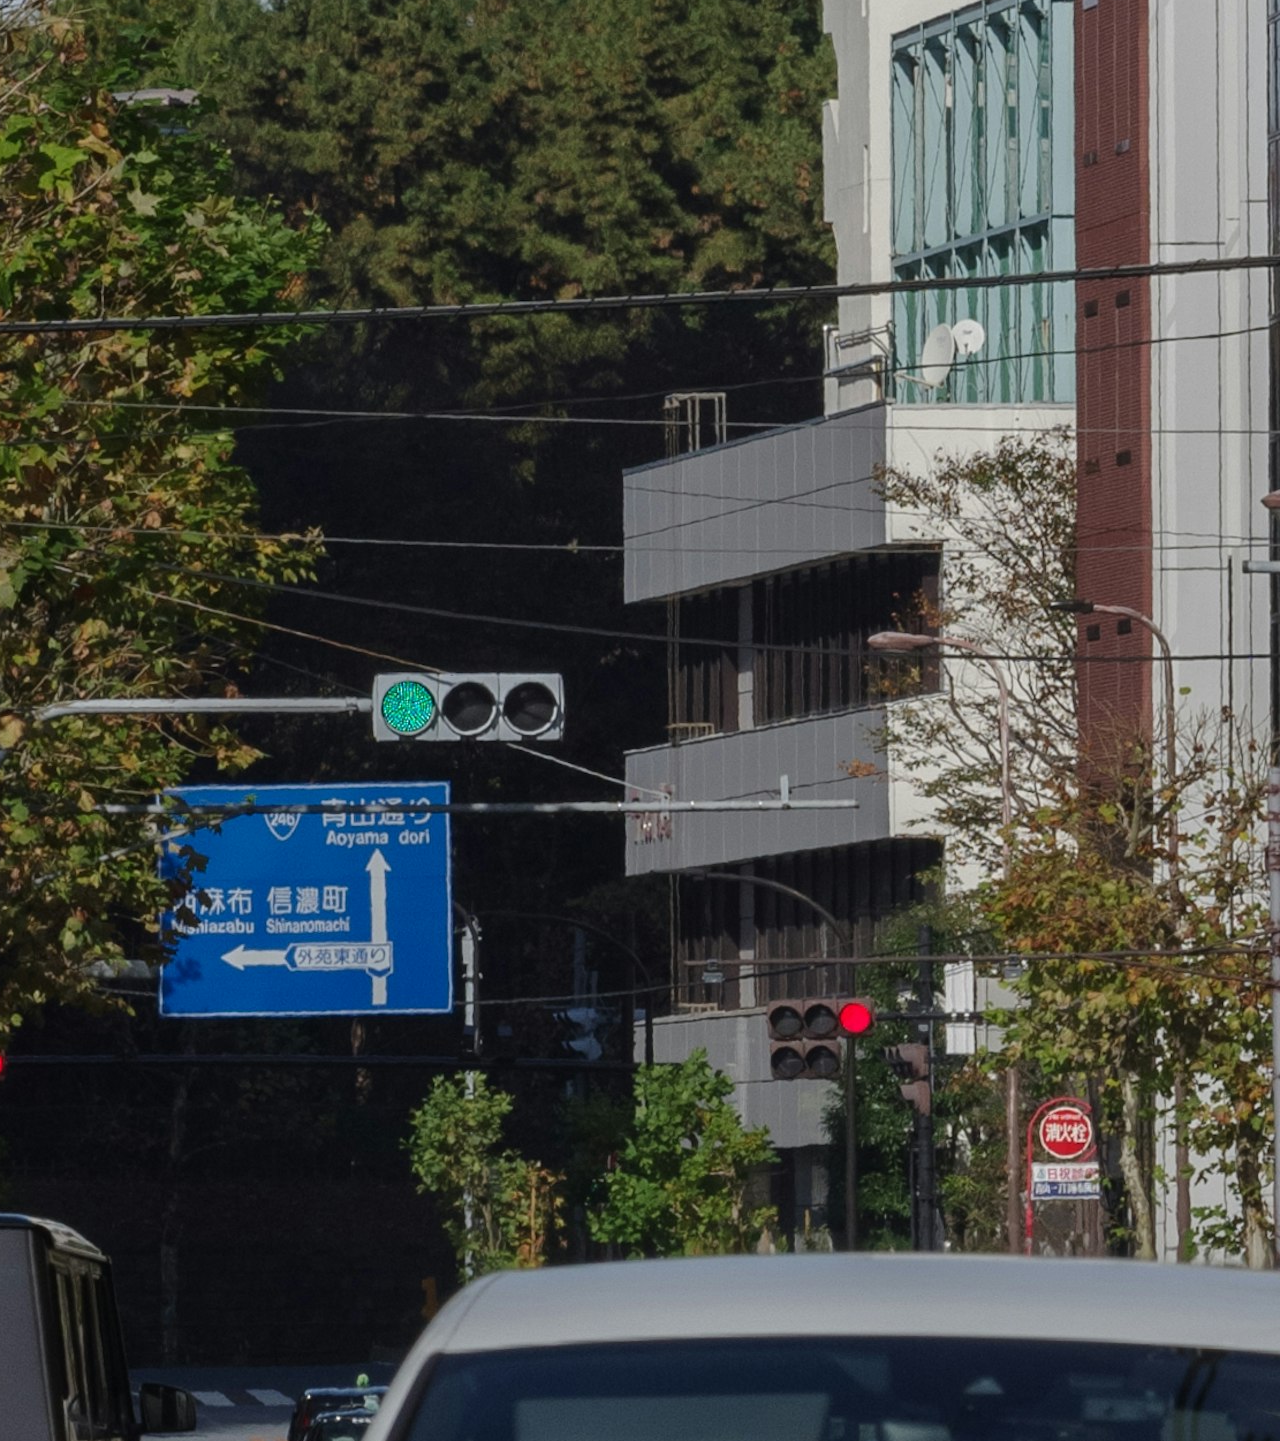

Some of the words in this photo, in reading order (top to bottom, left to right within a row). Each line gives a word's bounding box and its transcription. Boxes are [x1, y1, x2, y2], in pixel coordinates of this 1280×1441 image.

[322, 797, 431, 828] 青山通り
[326, 830, 389, 848] Aoyama
[398, 828, 430, 845] dori
[267, 886, 348, 916] 信濃町
[266, 916, 350, 934] Shinanomachi
[296, 947, 387, 966] 外苑東通り
[1045, 1122, 1087, 1143] 消火栓
